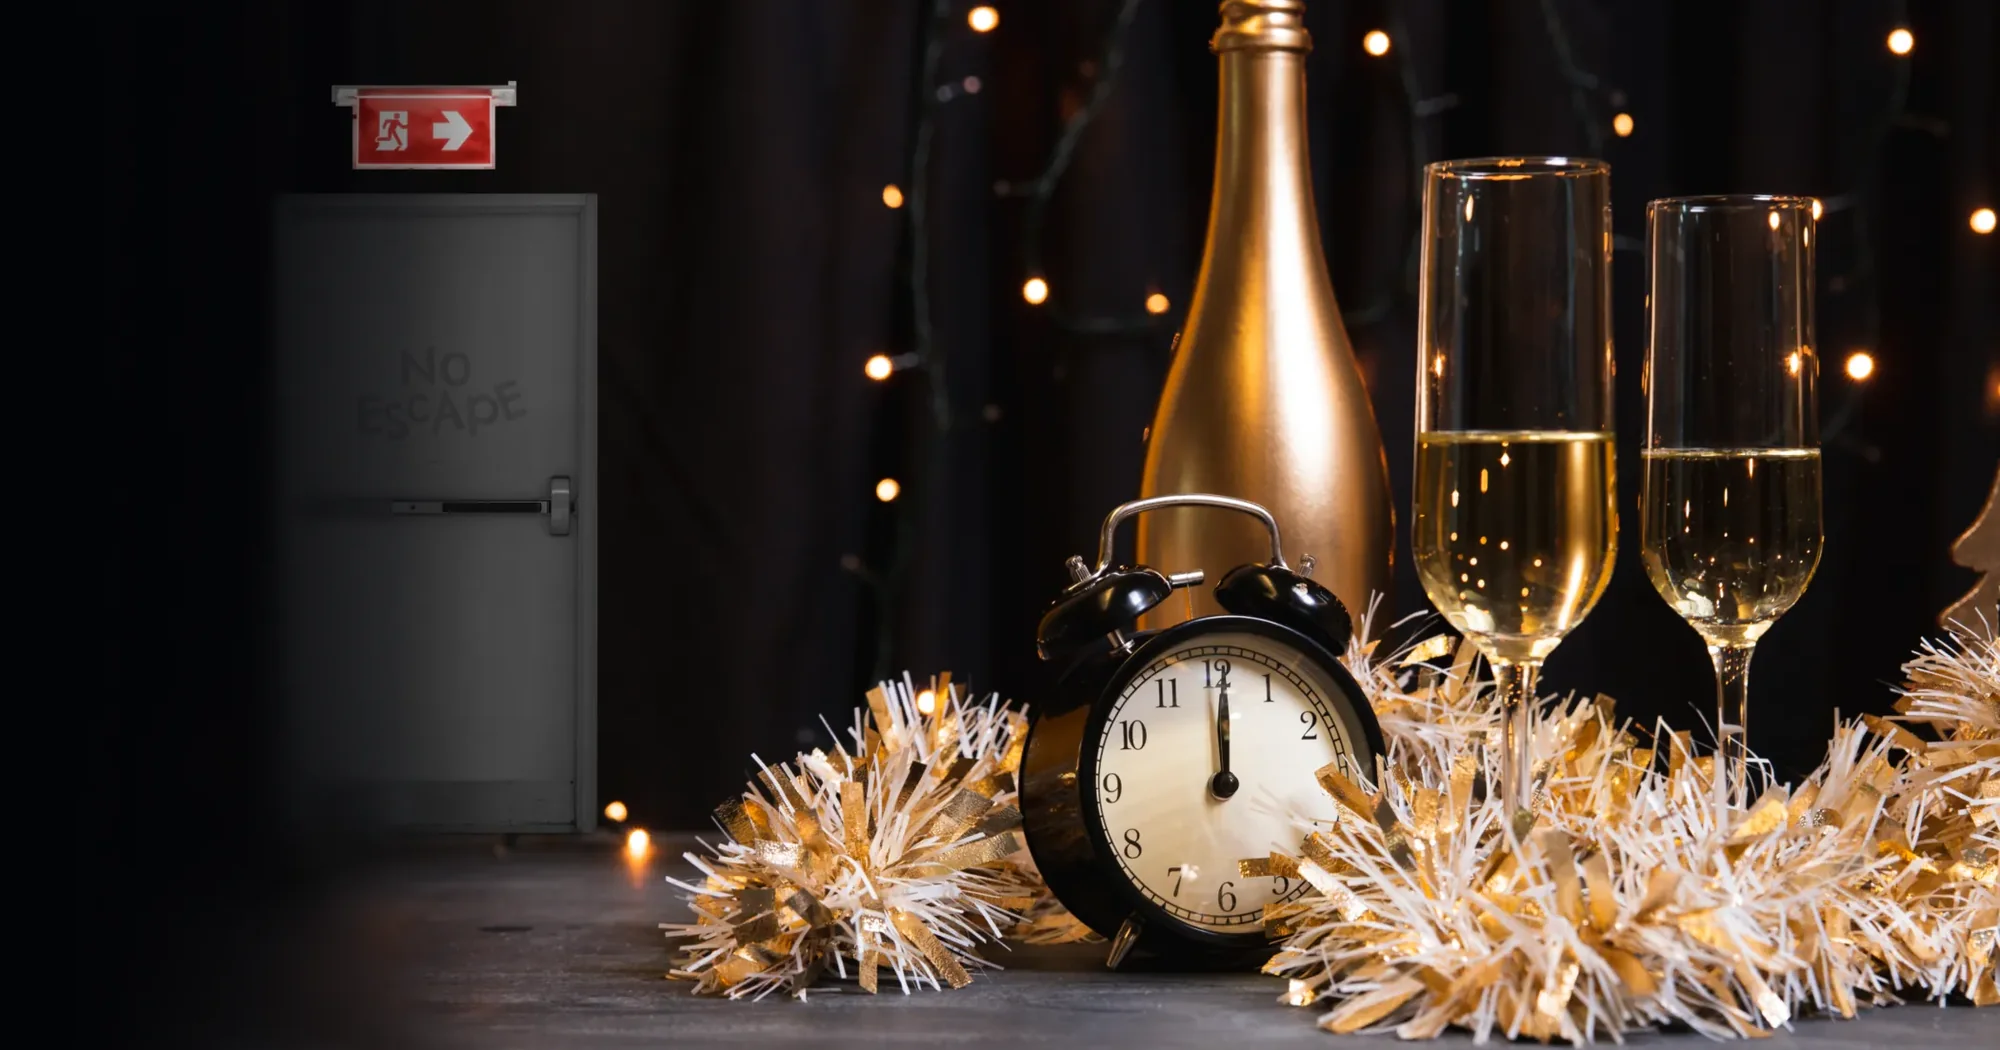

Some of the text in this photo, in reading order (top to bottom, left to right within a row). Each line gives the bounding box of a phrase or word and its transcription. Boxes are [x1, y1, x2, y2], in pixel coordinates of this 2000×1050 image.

[400, 345, 471, 387] NO
[355, 379, 528, 441] ESCAPE
[1201, 658, 1231, 689] 12
[1262, 673, 1275, 703] 1
[1155, 677, 1181, 708] 11
[1119, 719, 1147, 750] 10
[1300, 710, 1318, 740] 2
[1103, 772, 1122, 803] 9
[1123, 828, 1143, 859] 8
[1167, 867, 1187, 897] 7
[1217, 881, 1237, 912] 6
